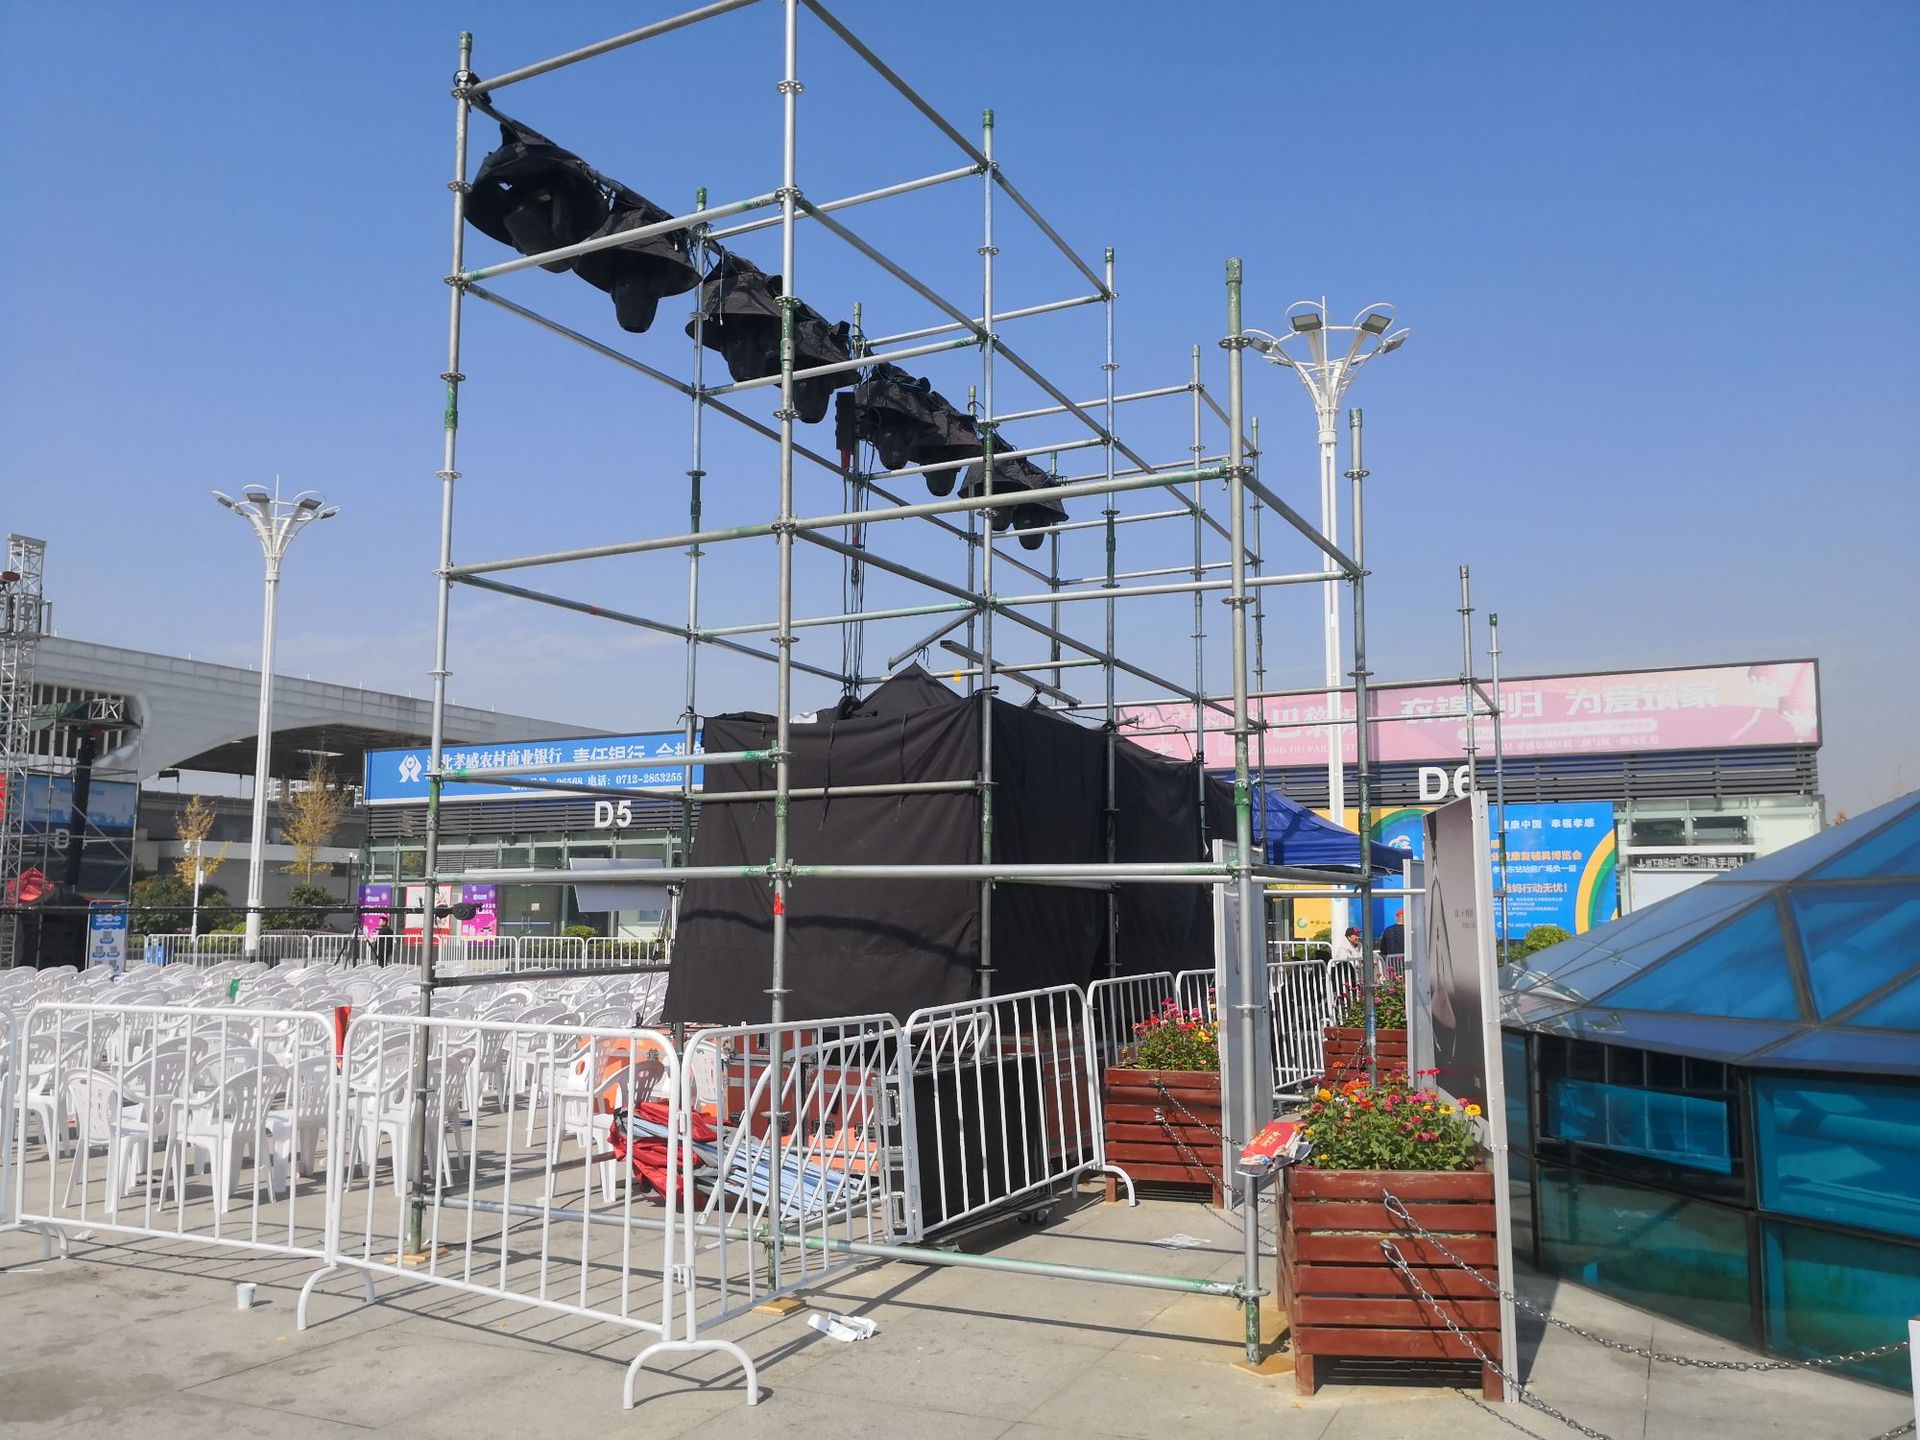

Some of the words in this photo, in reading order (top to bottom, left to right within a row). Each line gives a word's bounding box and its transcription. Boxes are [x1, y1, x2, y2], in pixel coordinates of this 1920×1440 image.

[1418, 765, 1473, 801] D6
[594, 800, 632, 828] D5
[1551, 818, 1595, 828] 幸福孝感
